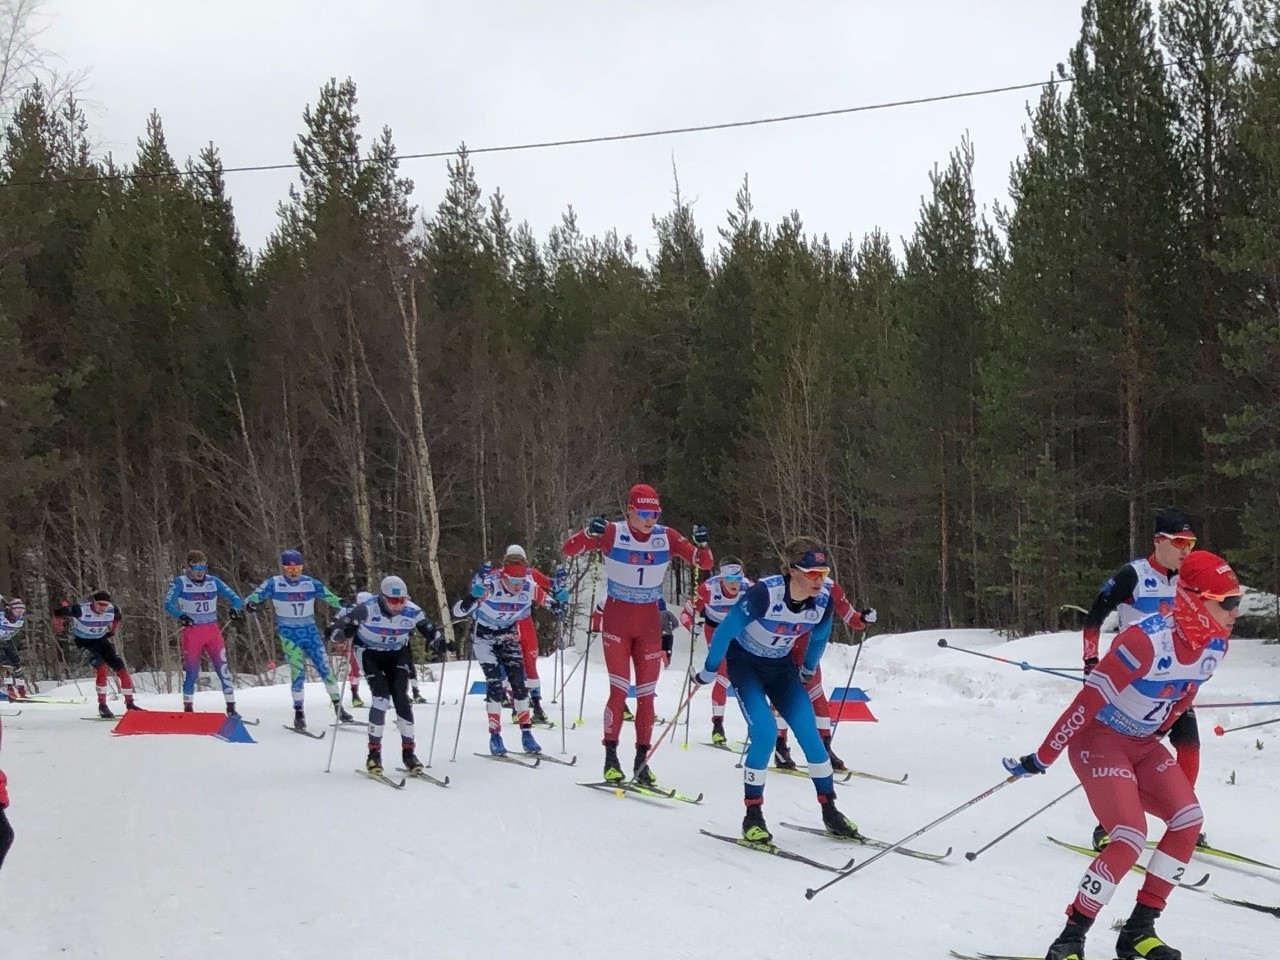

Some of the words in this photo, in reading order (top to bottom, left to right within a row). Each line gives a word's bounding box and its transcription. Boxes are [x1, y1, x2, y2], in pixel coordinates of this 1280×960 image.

[637, 567, 645, 586] 1
[195, 601, 210, 613] 20
[291, 602, 305, 616] 17
[1049, 706, 1086, 751] BOSCO
[1081, 874, 1102, 895] 29
